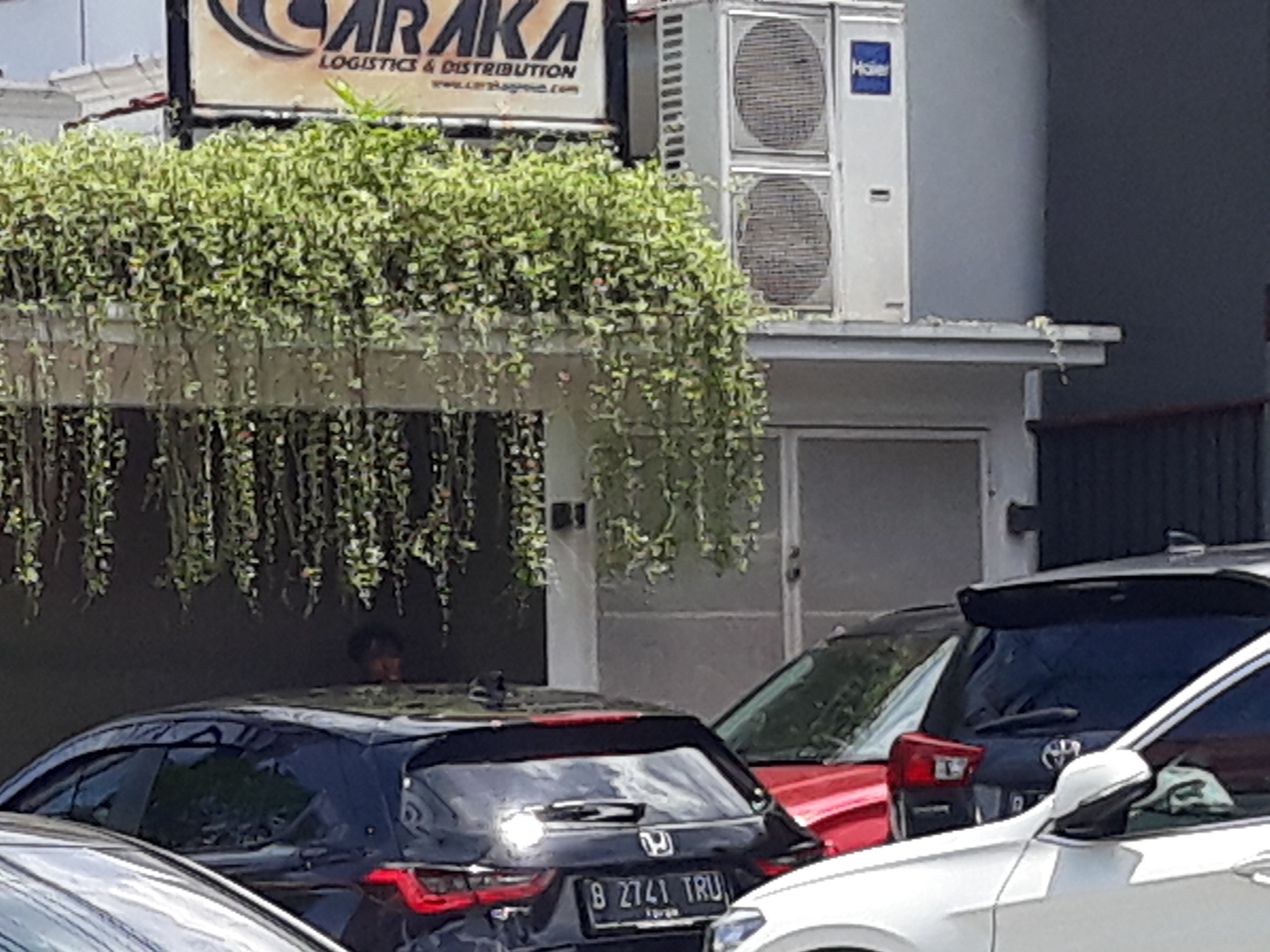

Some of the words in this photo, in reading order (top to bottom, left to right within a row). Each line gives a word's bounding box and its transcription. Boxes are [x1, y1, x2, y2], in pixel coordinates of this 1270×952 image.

[318, 55, 418, 73] LOGISTICS
[423, 59, 435, 75] &
[441, 60, 578, 79] DISTRIBUTION
[591, 881, 606, 910] B
[619, 879, 668, 908] 2741
[682, 874, 722, 903] TRU
